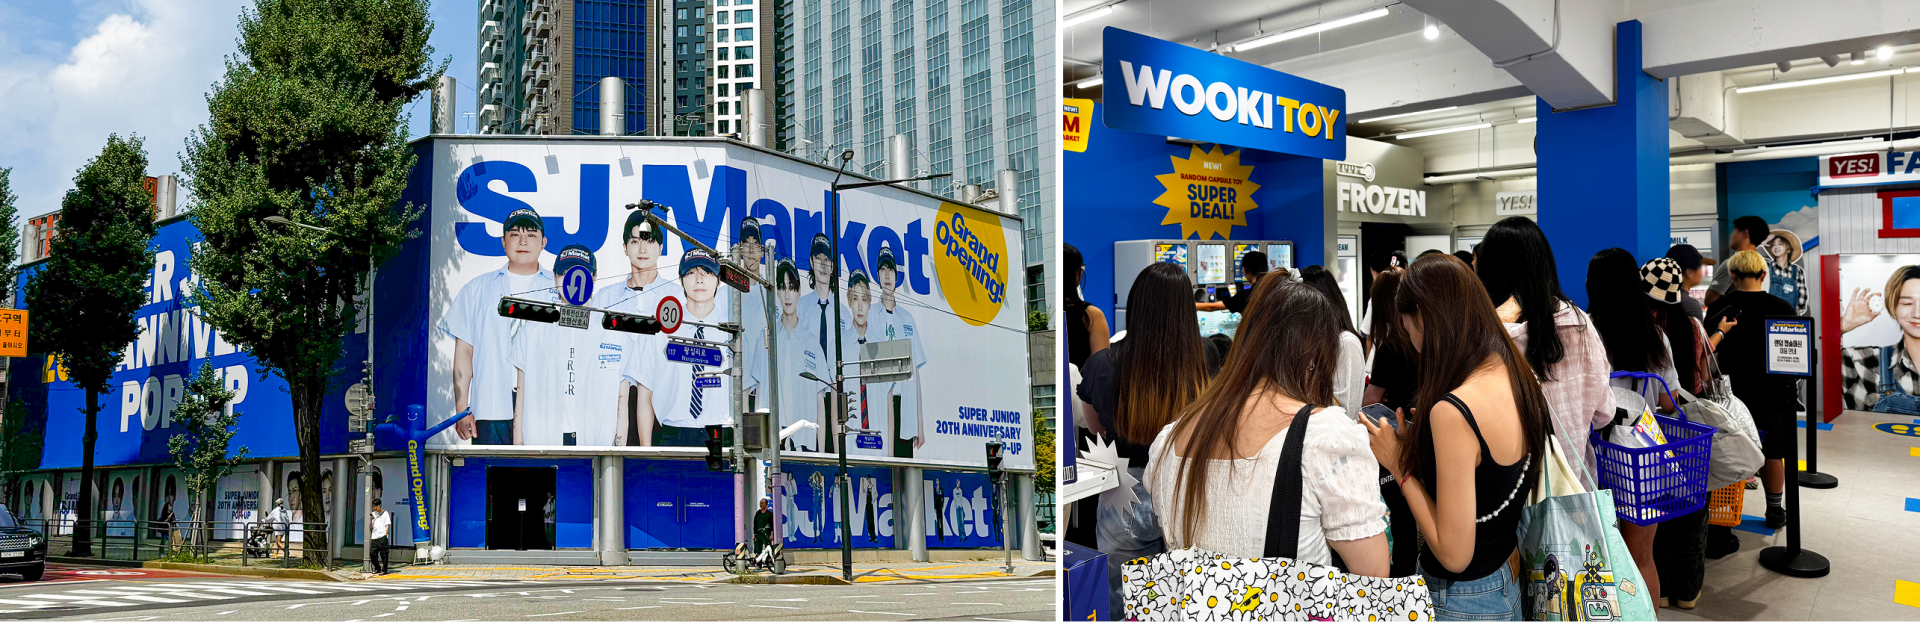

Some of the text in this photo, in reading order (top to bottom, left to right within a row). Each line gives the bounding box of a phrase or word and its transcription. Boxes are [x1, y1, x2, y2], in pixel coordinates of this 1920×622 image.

[1119, 60, 1340, 140] WOOKI TOY
[1063, 134, 1080, 142] ARKET
[1203, 161, 1222, 171] NEW!
[1834, 152, 1920, 175] YES! FA
[1180, 173, 1243, 186] RANDOM CAPSULE TOY
[1187, 183, 1237, 204] SUPER
[1337, 181, 1426, 217] FROZEN
[1500, 194, 1534, 211] YES!
[1190, 201, 1235, 220] DEAL!
[455, 160, 931, 296] SJ Market
[952, 212, 999, 274] Grand
[936, 220, 1005, 304] Opening!
[662, 306, 677, 323] 30
[958, 405, 1021, 425] SUPER JUNIOR
[936, 419, 1021, 440] 20TH ANNIVERSARY
[407, 439, 430, 530] Grand Opening!
[1380, 474, 1395, 485] ENTE
[217, 500, 230, 510] 20TH
